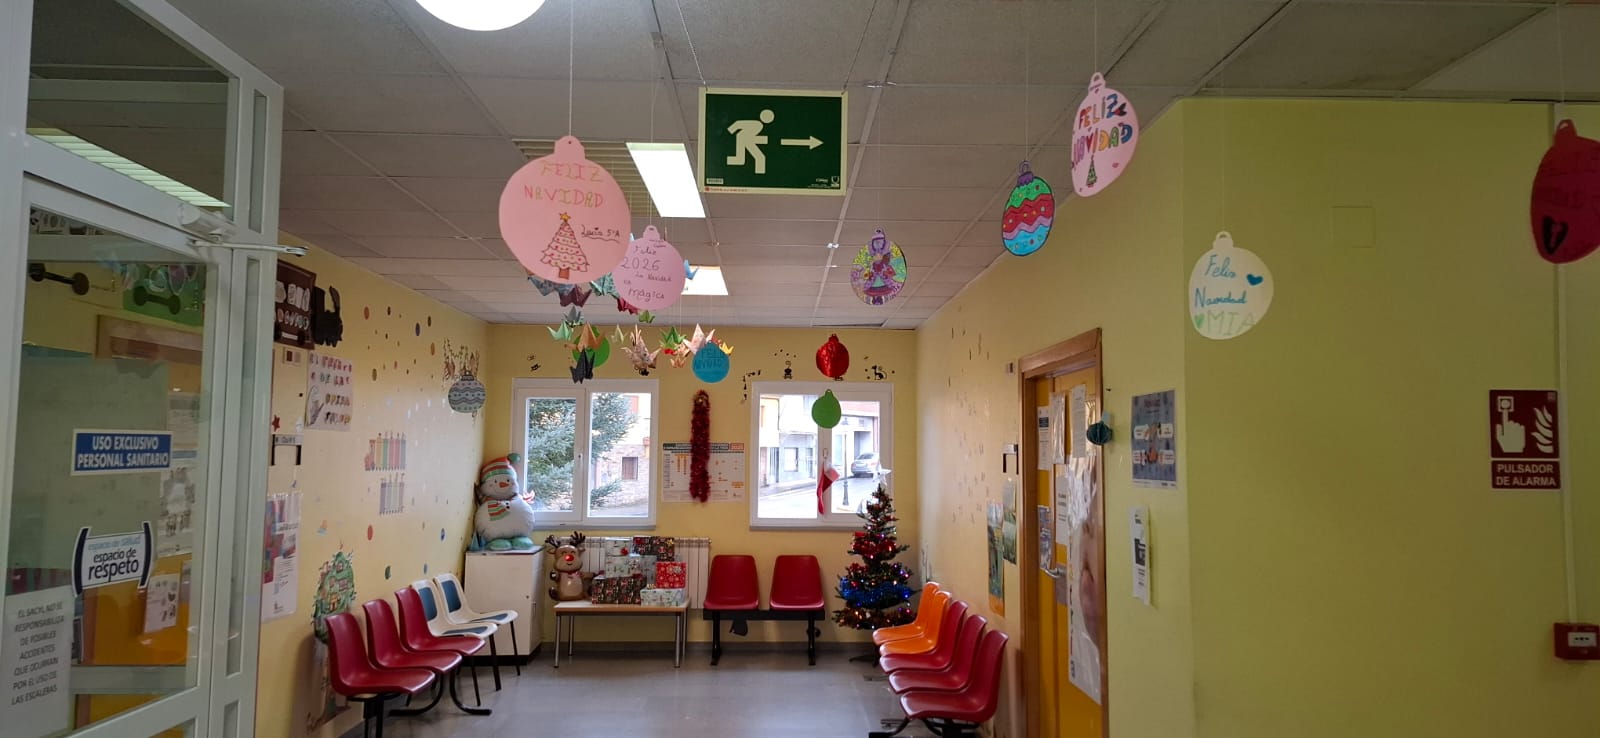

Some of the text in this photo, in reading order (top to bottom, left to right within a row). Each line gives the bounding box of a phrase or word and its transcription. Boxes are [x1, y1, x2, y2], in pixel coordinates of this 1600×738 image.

[1078, 93, 1118, 130] FELIZ
[1073, 124, 1133, 166] NAVIDAD
[541, 161, 604, 183] FELIZ
[523, 184, 604, 208] NAVIDAD
[621, 256, 661, 271] 2026
[1206, 309, 1256, 336] MIA
[92, 435, 159, 450] USO EXCLUSIVO
[77, 452, 169, 468] PERSONAL SANITARIO
[1497, 464, 1554, 473] PULSADOR
[1495, 476, 1557, 486] DE ALARMA
[93, 547, 137, 564] espacio de
[88, 559, 140, 582] respeto
[11, 694, 25, 705] LAS
